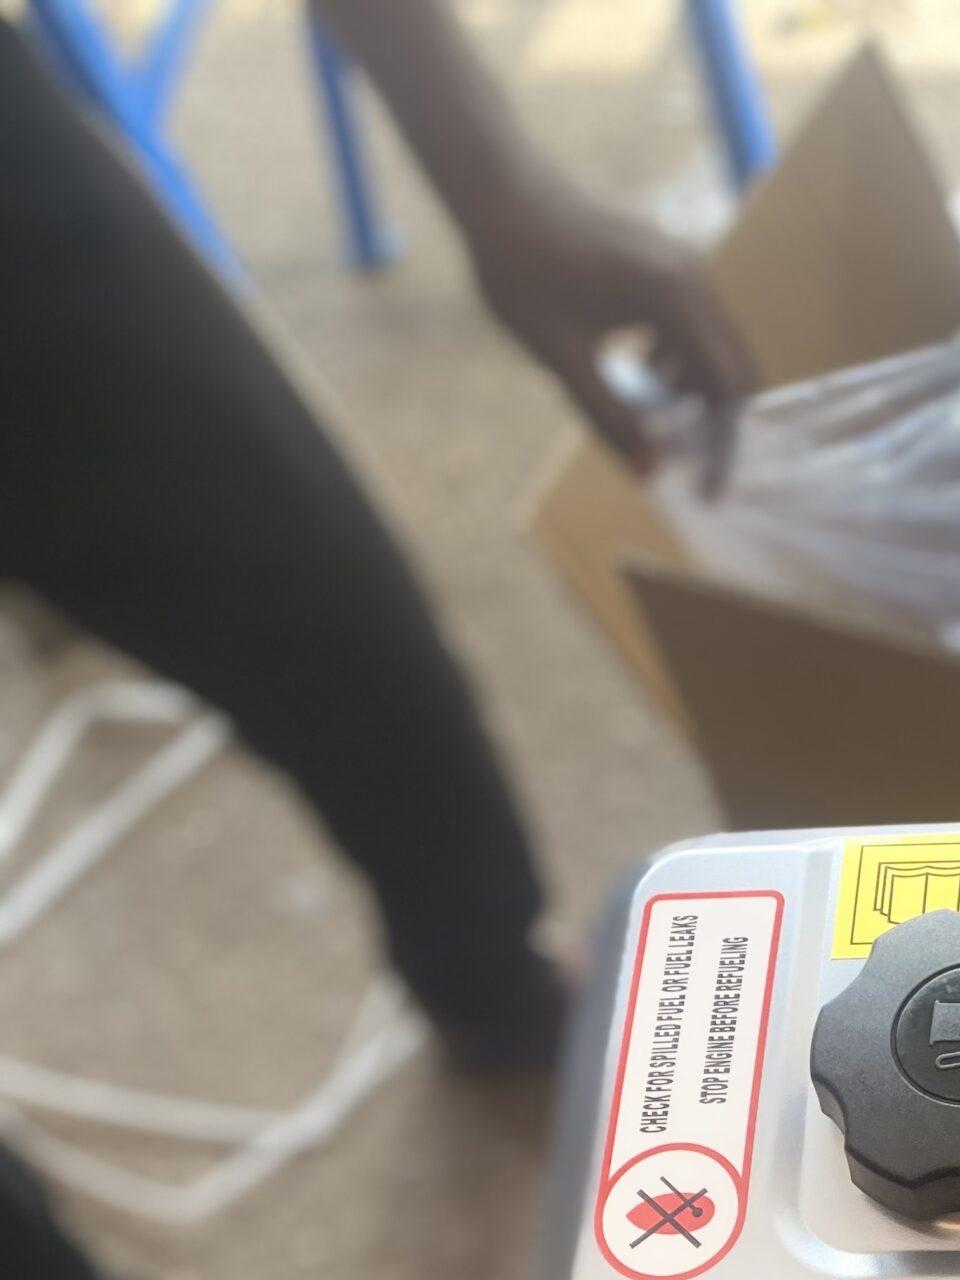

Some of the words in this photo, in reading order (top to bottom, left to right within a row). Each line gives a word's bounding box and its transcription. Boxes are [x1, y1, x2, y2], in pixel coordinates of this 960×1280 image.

[668, 915, 699, 948] LEAKS
[664, 949, 693, 976] FUEL
[715, 936, 749, 991] REFUELING
[661, 977, 689, 992] OR
[657, 994, 686, 1021] FUEL
[709, 993, 741, 1034] BEFORE
[649, 1023, 682, 1069] SPILLED
[703, 1035, 735, 1075] ENGINE
[645, 1070, 675, 1092] FOR
[699, 1076, 729, 1105] STOP
[639, 1094, 671, 1134] CHECK
